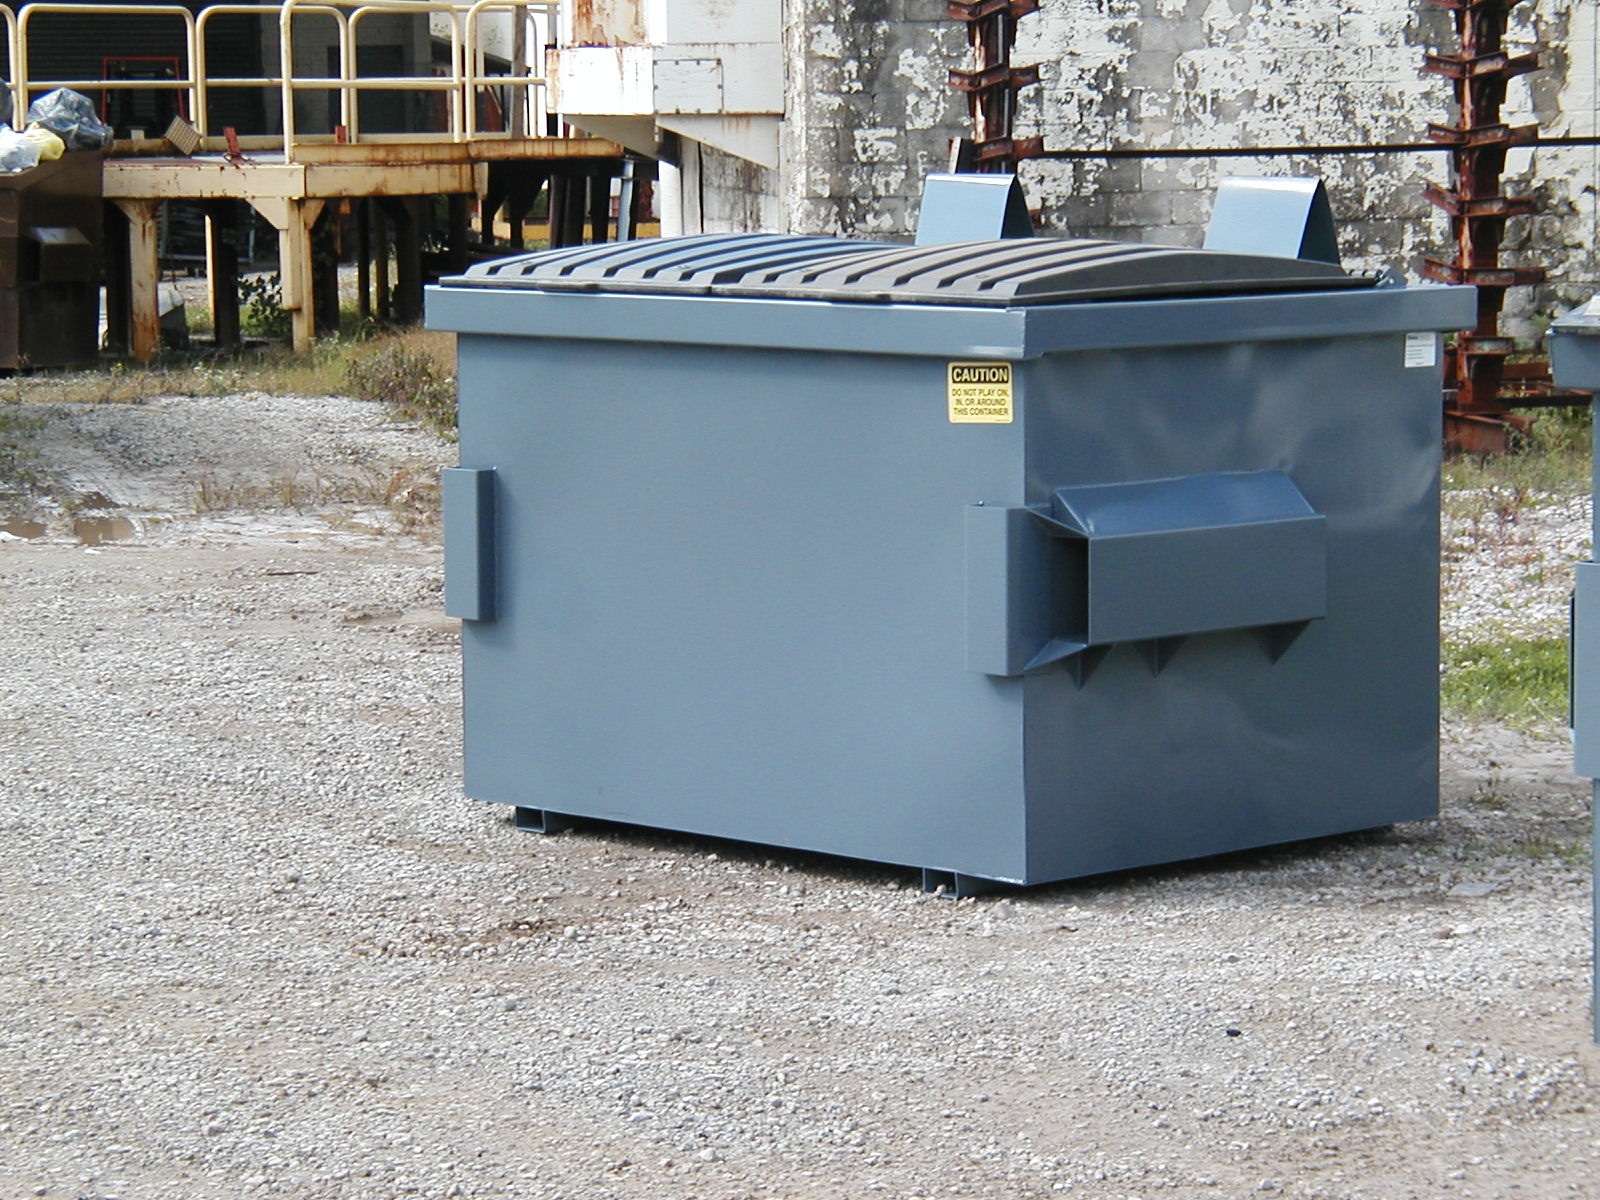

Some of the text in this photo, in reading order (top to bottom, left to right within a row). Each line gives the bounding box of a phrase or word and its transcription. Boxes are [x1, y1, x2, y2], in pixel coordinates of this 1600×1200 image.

[952, 368, 1009, 382] CAUTION
[952, 388, 961, 397] DO
[963, 388, 977, 397] NOT
[978, 388, 995, 397] PLAY
[965, 398, 975, 406] OR
[977, 398, 1006, 406] AROUND
[953, 407, 1008, 416] THIS CONTAINER
